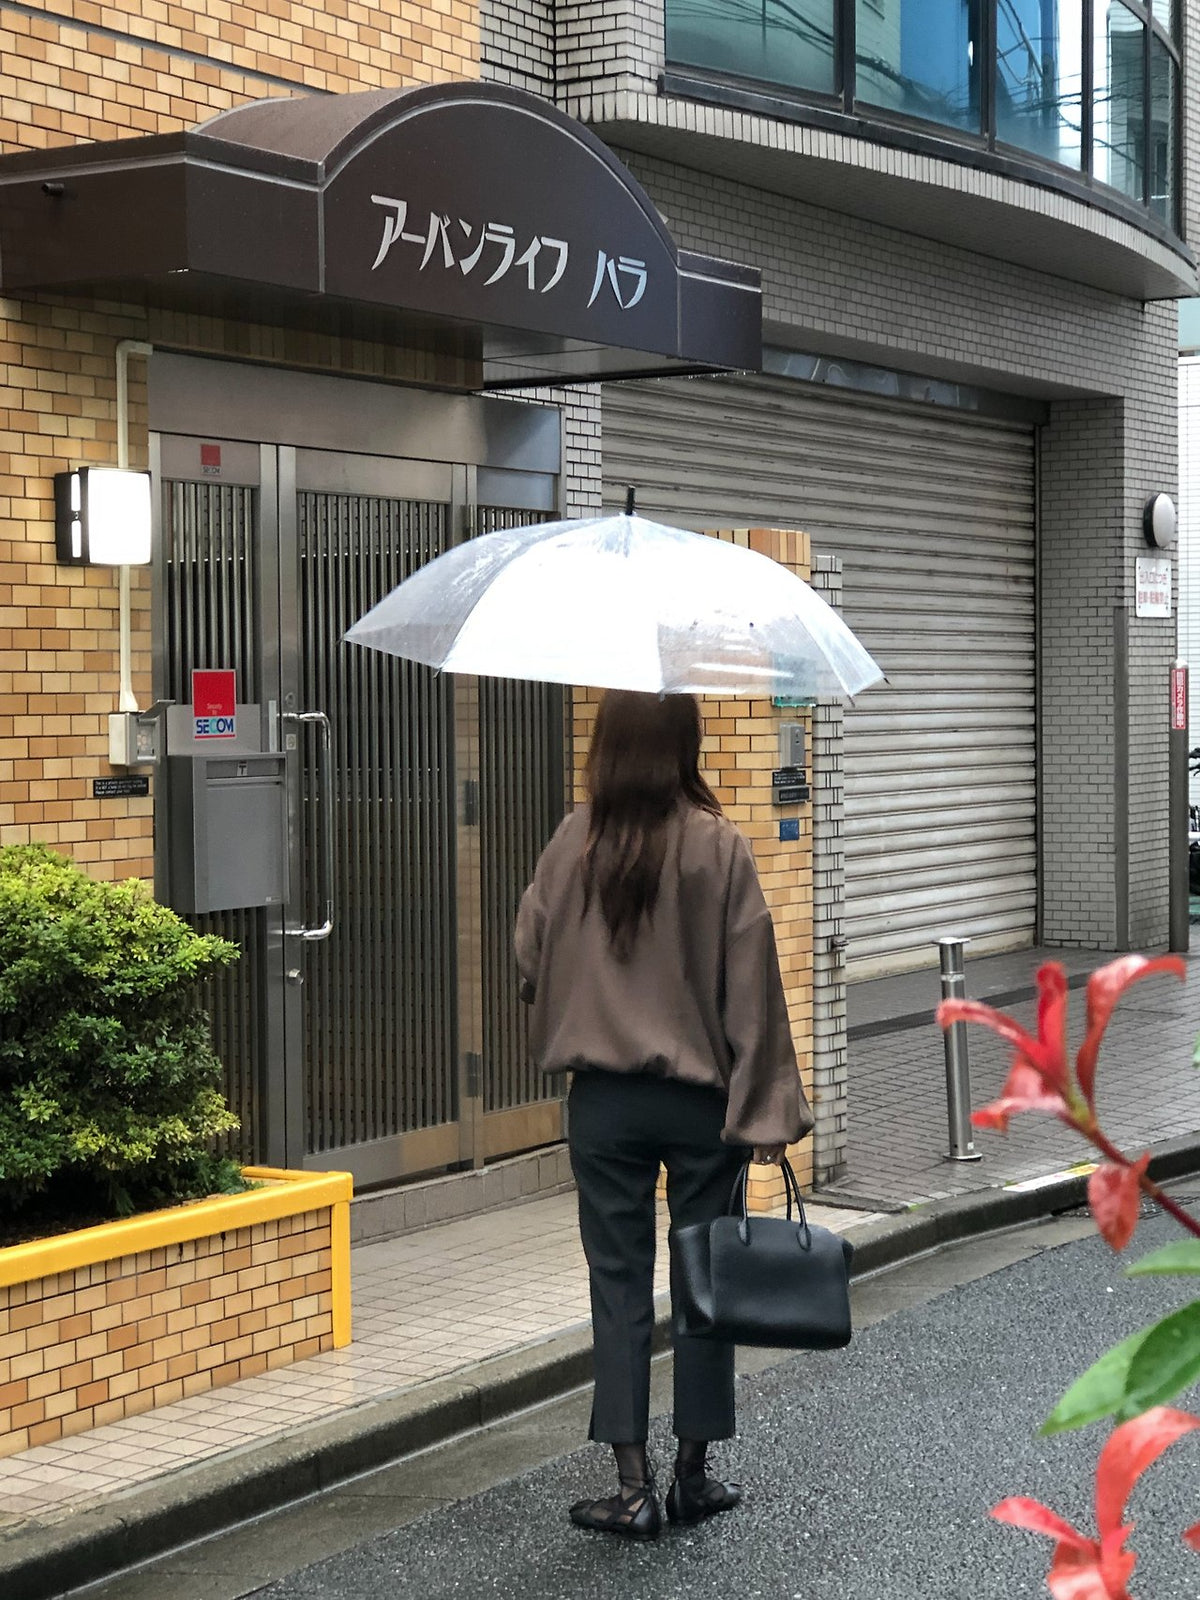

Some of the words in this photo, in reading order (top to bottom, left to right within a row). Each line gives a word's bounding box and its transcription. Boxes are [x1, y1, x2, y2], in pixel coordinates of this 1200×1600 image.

[371, 194, 569, 293] アーバンライフ
[586, 249, 648, 310] ハラ
[196, 718, 234, 734] SECOM
